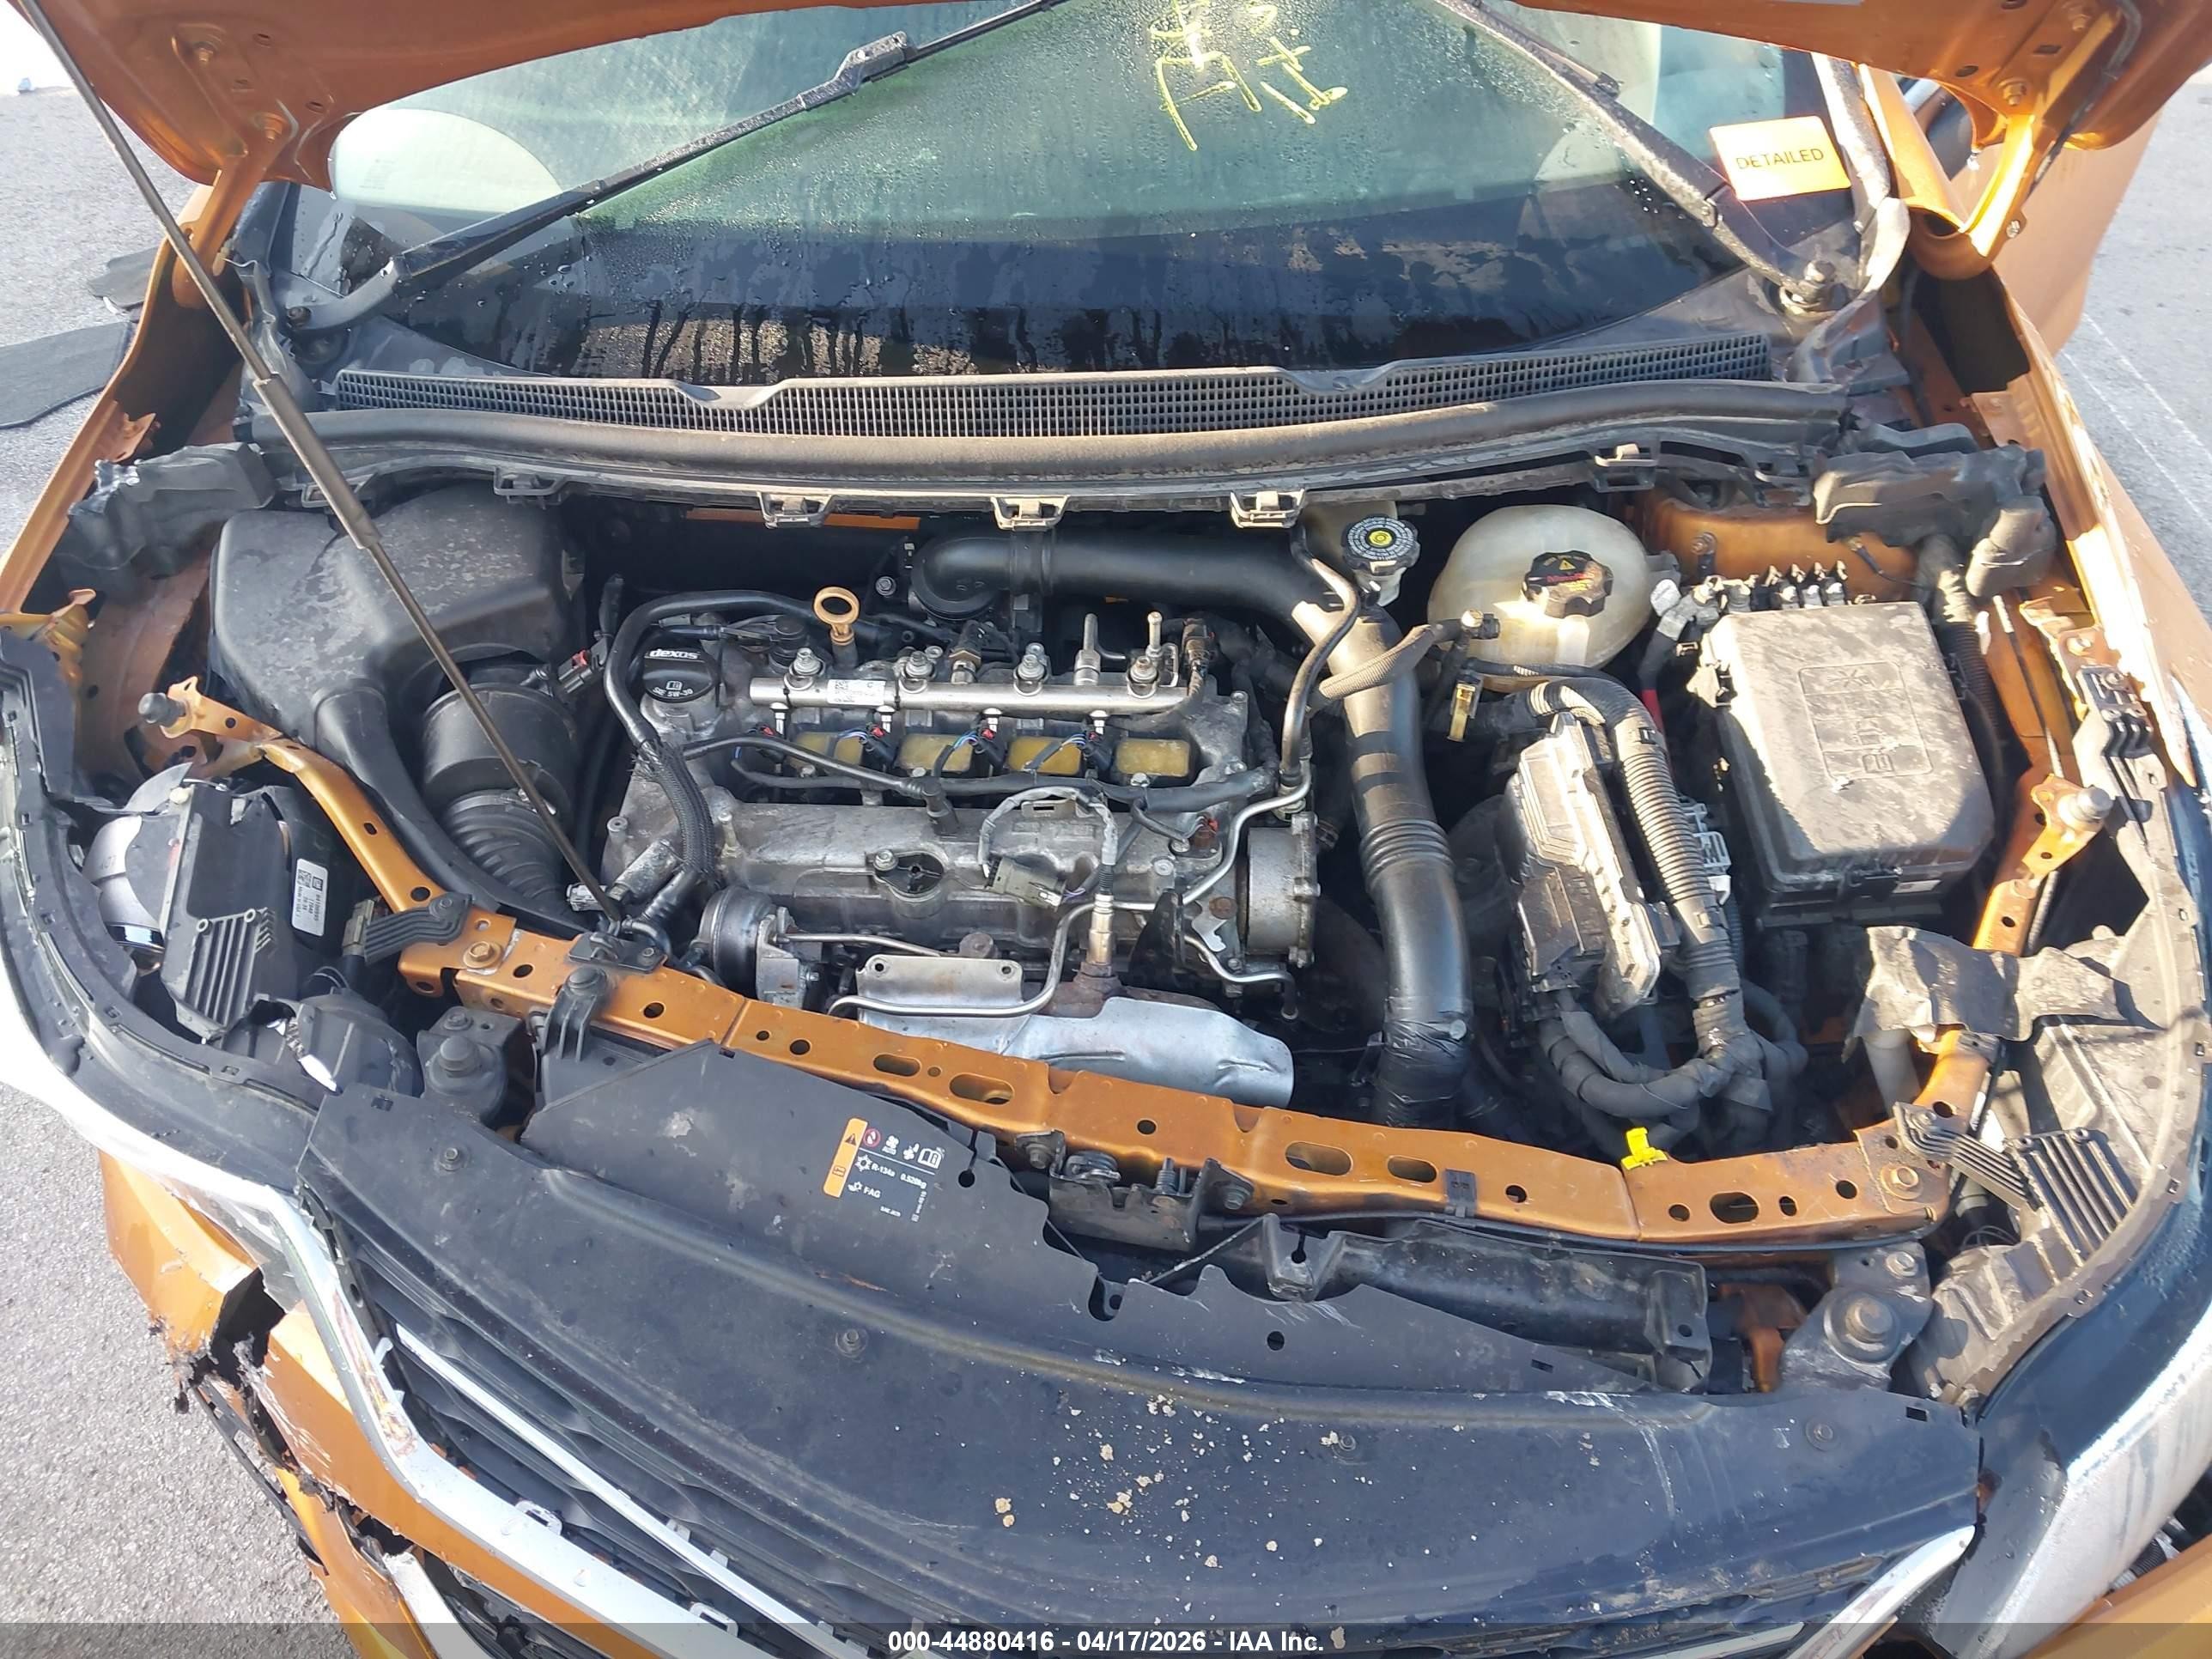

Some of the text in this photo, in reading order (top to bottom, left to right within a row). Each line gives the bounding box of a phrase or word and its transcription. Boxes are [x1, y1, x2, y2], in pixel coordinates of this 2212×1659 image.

[1735, 148, 1824, 170] DETAILED
[649, 648, 698, 659] dexos
[653, 686, 694, 697] SAE 5W-30
